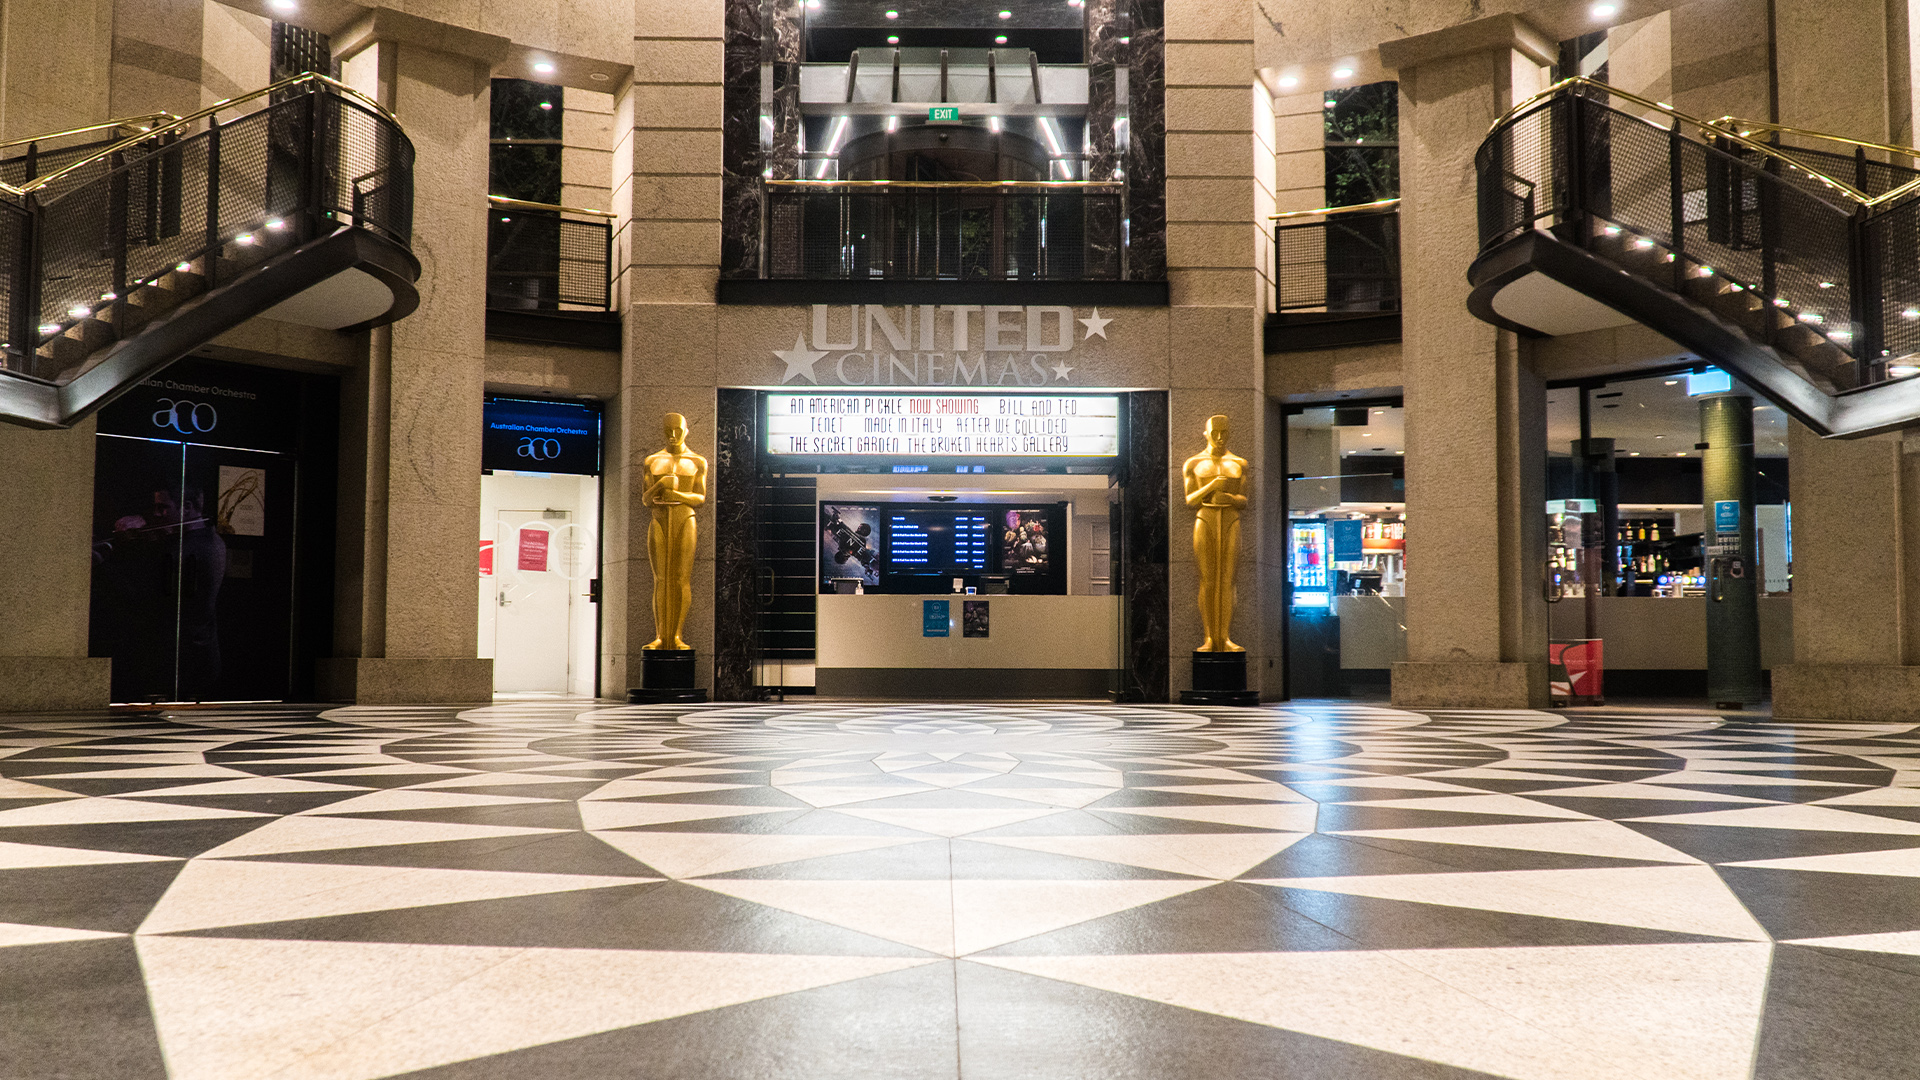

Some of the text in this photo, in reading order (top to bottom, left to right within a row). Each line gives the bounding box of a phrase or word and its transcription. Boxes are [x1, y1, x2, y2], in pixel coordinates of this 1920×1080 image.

[934, 109, 953, 119] EXIT
[812, 304, 1074, 351] UNITED
[836, 352, 1050, 386] CINEMAS
[165, 380, 210, 394] Chamber
[211, 386, 257, 400] Orchestra
[152, 397, 217, 434] aco
[790, 398, 804, 414] AN
[809, 398, 860, 414] AMERICAN
[909, 399, 931, 414] NOW
[936, 398, 979, 414] SHOWING
[999, 398, 1024, 415] BILL
[1031, 399, 1052, 415] AND
[1058, 399, 1077, 415] TED
[490, 422, 588, 435] Australian Chamber Orchestra
[811, 416, 1067, 436] TENET MADE IN ITALY AFTER WE COLLIDED
[517, 436, 561, 461] aco
[789, 436, 1069, 453] THE SECRET GARDEN THE BROKEN HEARTS GALLERY
